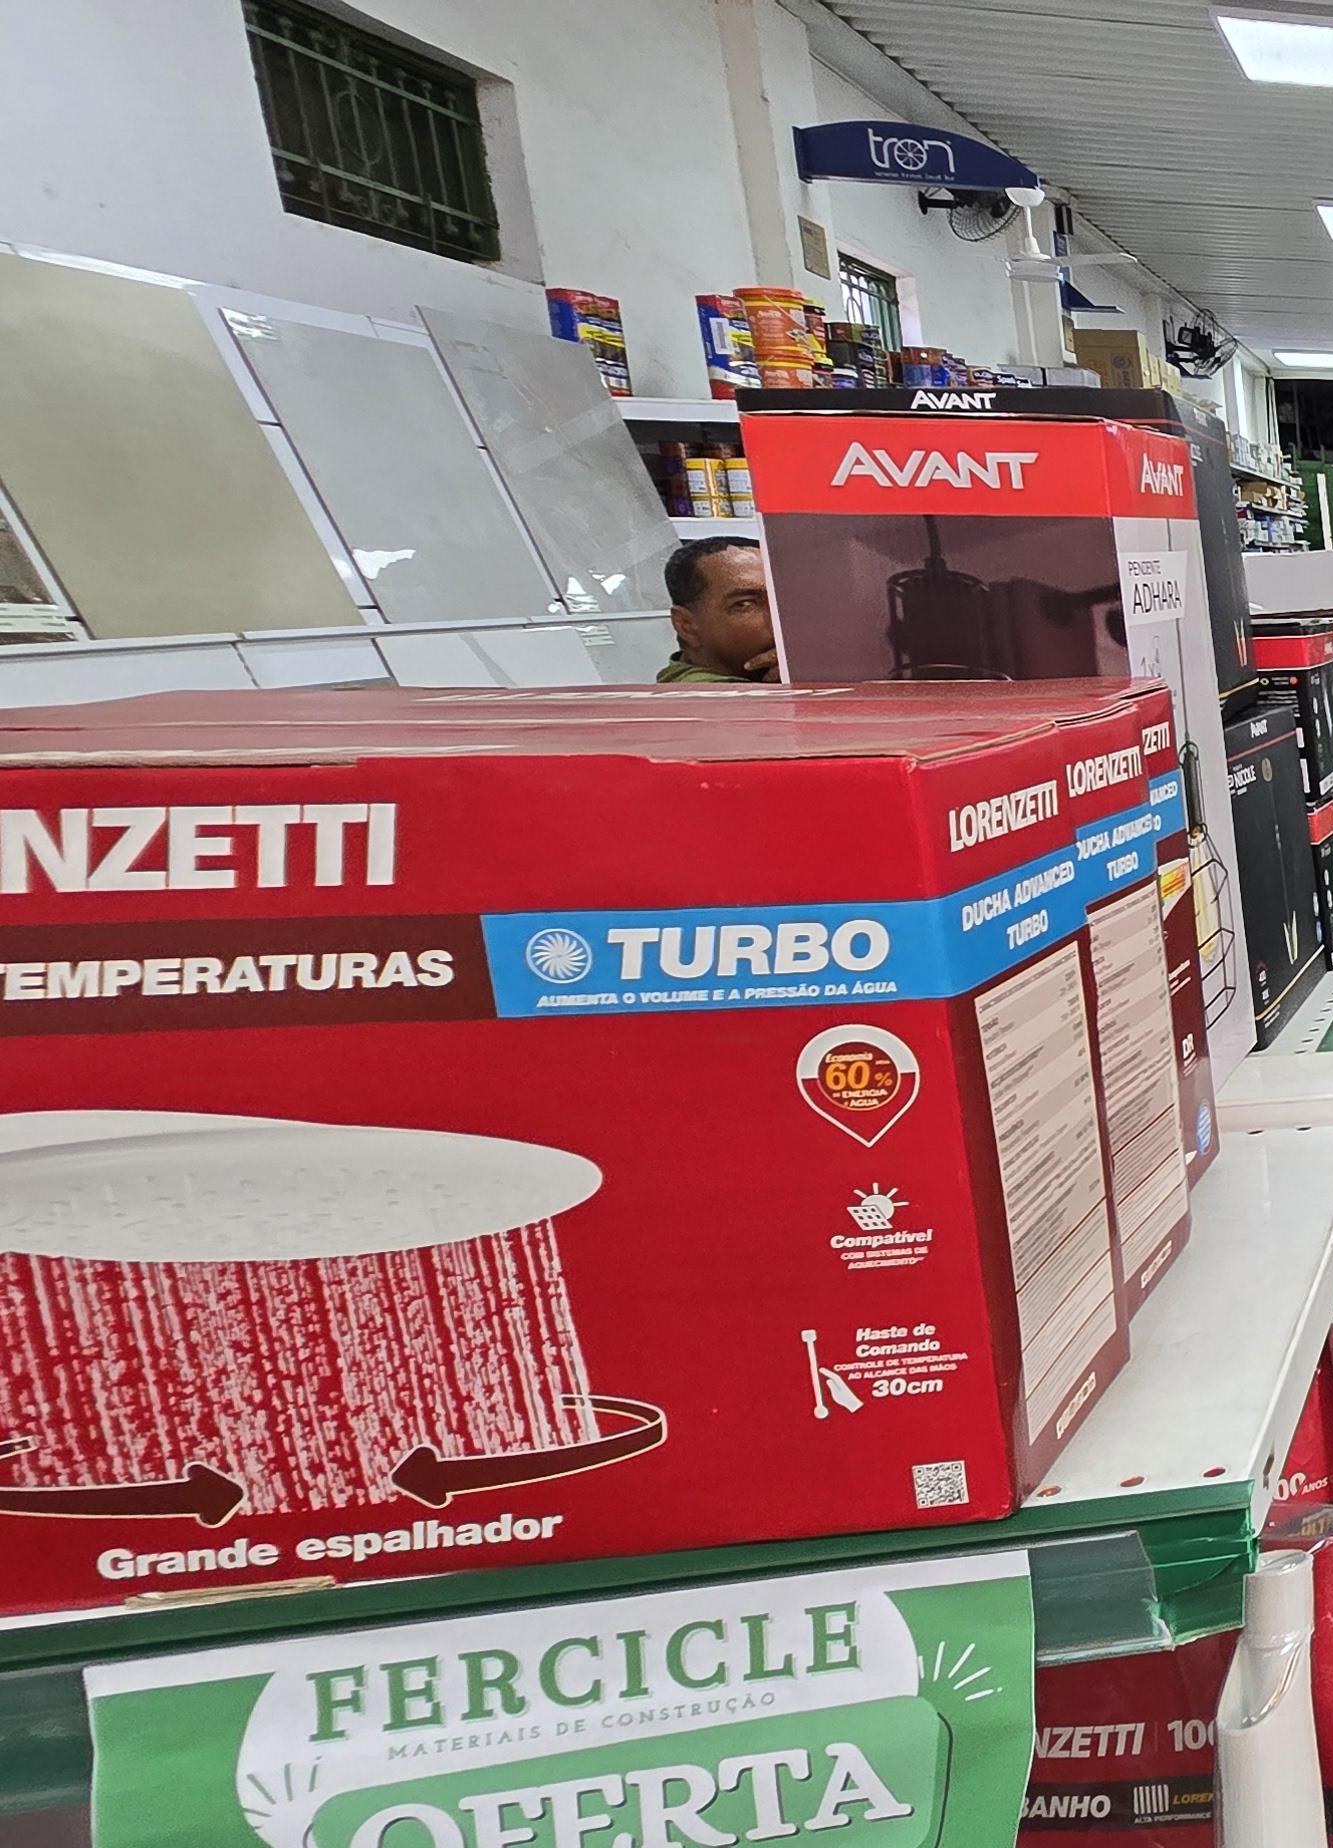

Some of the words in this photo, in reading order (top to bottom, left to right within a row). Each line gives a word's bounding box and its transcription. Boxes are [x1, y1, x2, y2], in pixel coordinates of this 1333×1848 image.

[868, 128, 956, 173] tron
[911, 389, 996, 410] AVANT
[830, 441, 1039, 490] AVANT
[1141, 453, 1184, 497] AVANT
[1132, 579, 1183, 615] ADHARA
[1142, 721, 1171, 756] ZETTI
[1066, 746, 1142, 798] LORENZETTI
[949, 780, 1059, 853] LORENZETTI
[1106, 851, 1139, 881] TURBO
[961, 888, 1012, 932] DUCHA
[1013, 860, 1075, 909] ADVANCED
[1006, 909, 1049, 950] TURBO
[607, 919, 891, 981] TURBO
[536, 991, 619, 1008] AUMENTA
[623, 991, 634, 1004] O
[640, 989, 709, 1004] VOLUME
[713, 989, 725, 1001] E
[728, 988, 740, 1001] A
[744, 983, 820, 1000] PRESSÃO
[824, 984, 848, 997] DA
[852, 979, 898, 995] ÁGUA
[830, 1228, 934, 1250] Compatível
[856, 1325, 907, 1342] Haste
[912, 1322, 936, 1337] de
[856, 1339, 940, 1359] Comando
[833, 1359, 885, 1372] CONTROLE
[886, 1358, 900, 1368] DE
[901, 1352, 969, 1366] TEMPERATURA
[848, 1370, 862, 1380] AO
[863, 1367, 908, 1380] ALCANCE
[909, 1365, 928, 1376] DAS
[871, 1377, 944, 1398] 30cm
[1301, 1475, 1329, 1495] ANOS
[96, 1538, 280, 1581] Grande
[296, 1514, 564, 1563] espalhador
[305, 1600, 862, 1744] FERCICLE
[386, 1723, 542, 1761] MATERIAIS
[556, 1715, 588, 1737] DE
[600, 1690, 778, 1728] CONSTRUÇÃO
[1134, 1813, 1153, 1824] ALTA
